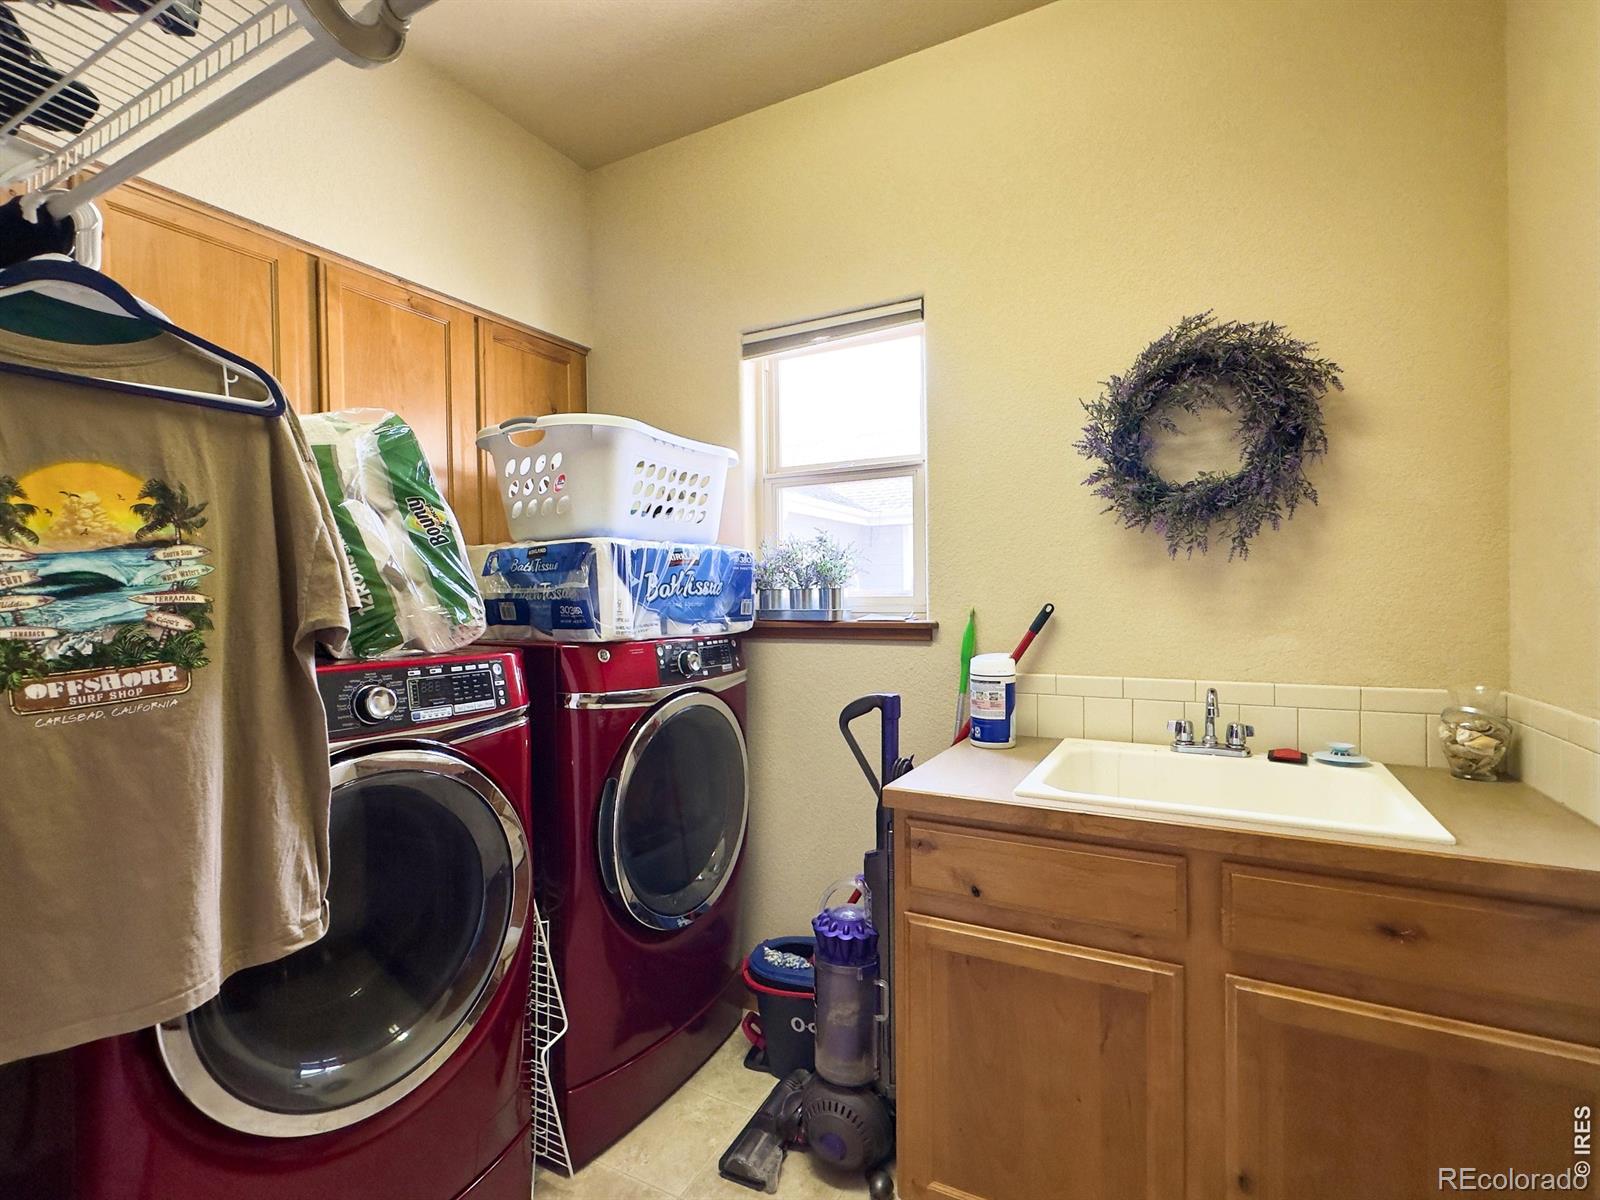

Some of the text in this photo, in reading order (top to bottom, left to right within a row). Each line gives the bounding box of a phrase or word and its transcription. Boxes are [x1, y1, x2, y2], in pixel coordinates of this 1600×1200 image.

[405, 496, 450, 548] Bounty
[511, 558, 559, 573] Bath Tissue
[644, 569, 724, 602] Bath Tissue
[155, 595, 196, 604] TERRAMAR
[24, 665, 178, 700] OFFSHORE
[68, 687, 144, 706] SURF SHOP
[111, 698, 179, 717] CALIFORNIA
